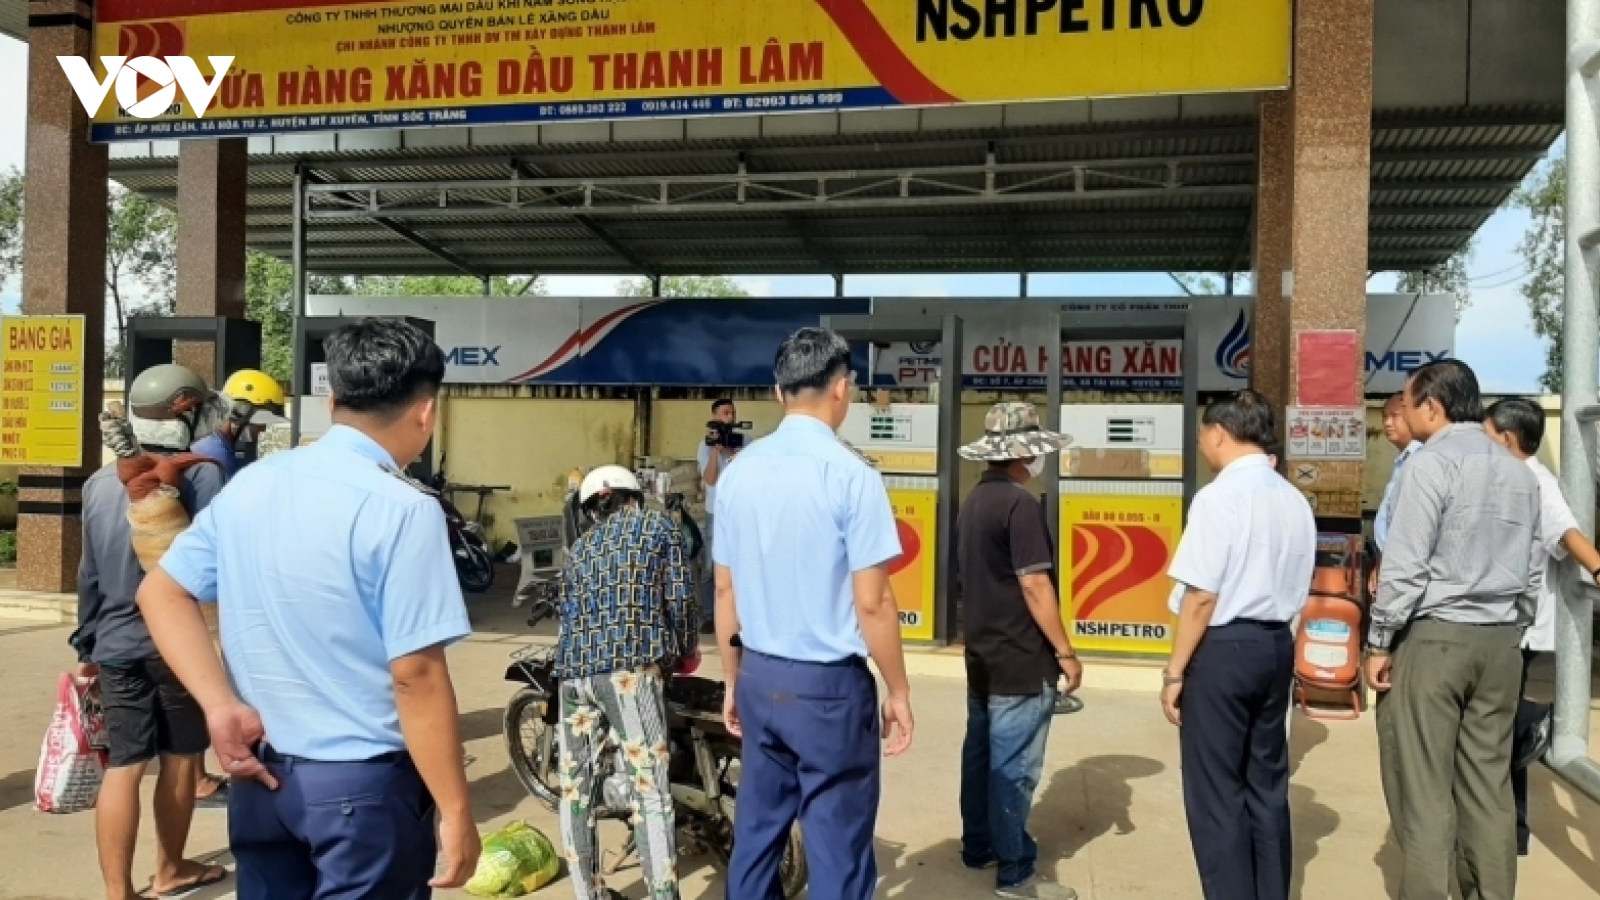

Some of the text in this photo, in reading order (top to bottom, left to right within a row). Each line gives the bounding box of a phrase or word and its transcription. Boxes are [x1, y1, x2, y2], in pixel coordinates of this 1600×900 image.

[325, 11, 340, 21] TY
[278, 64, 373, 106] HÀNG
[386, 58, 482, 101] XĂNG
[498, 45, 574, 96] DẦU
[589, 47, 723, 91] THANH
[740, 37, 823, 85] LÂM
[10, 319, 73, 350] BẢNG GIÁ
[973, 337, 1027, 373] CỬA
[1122, 341, 1182, 374] XĂN
[1075, 621, 1166, 638] NSHPETRO
